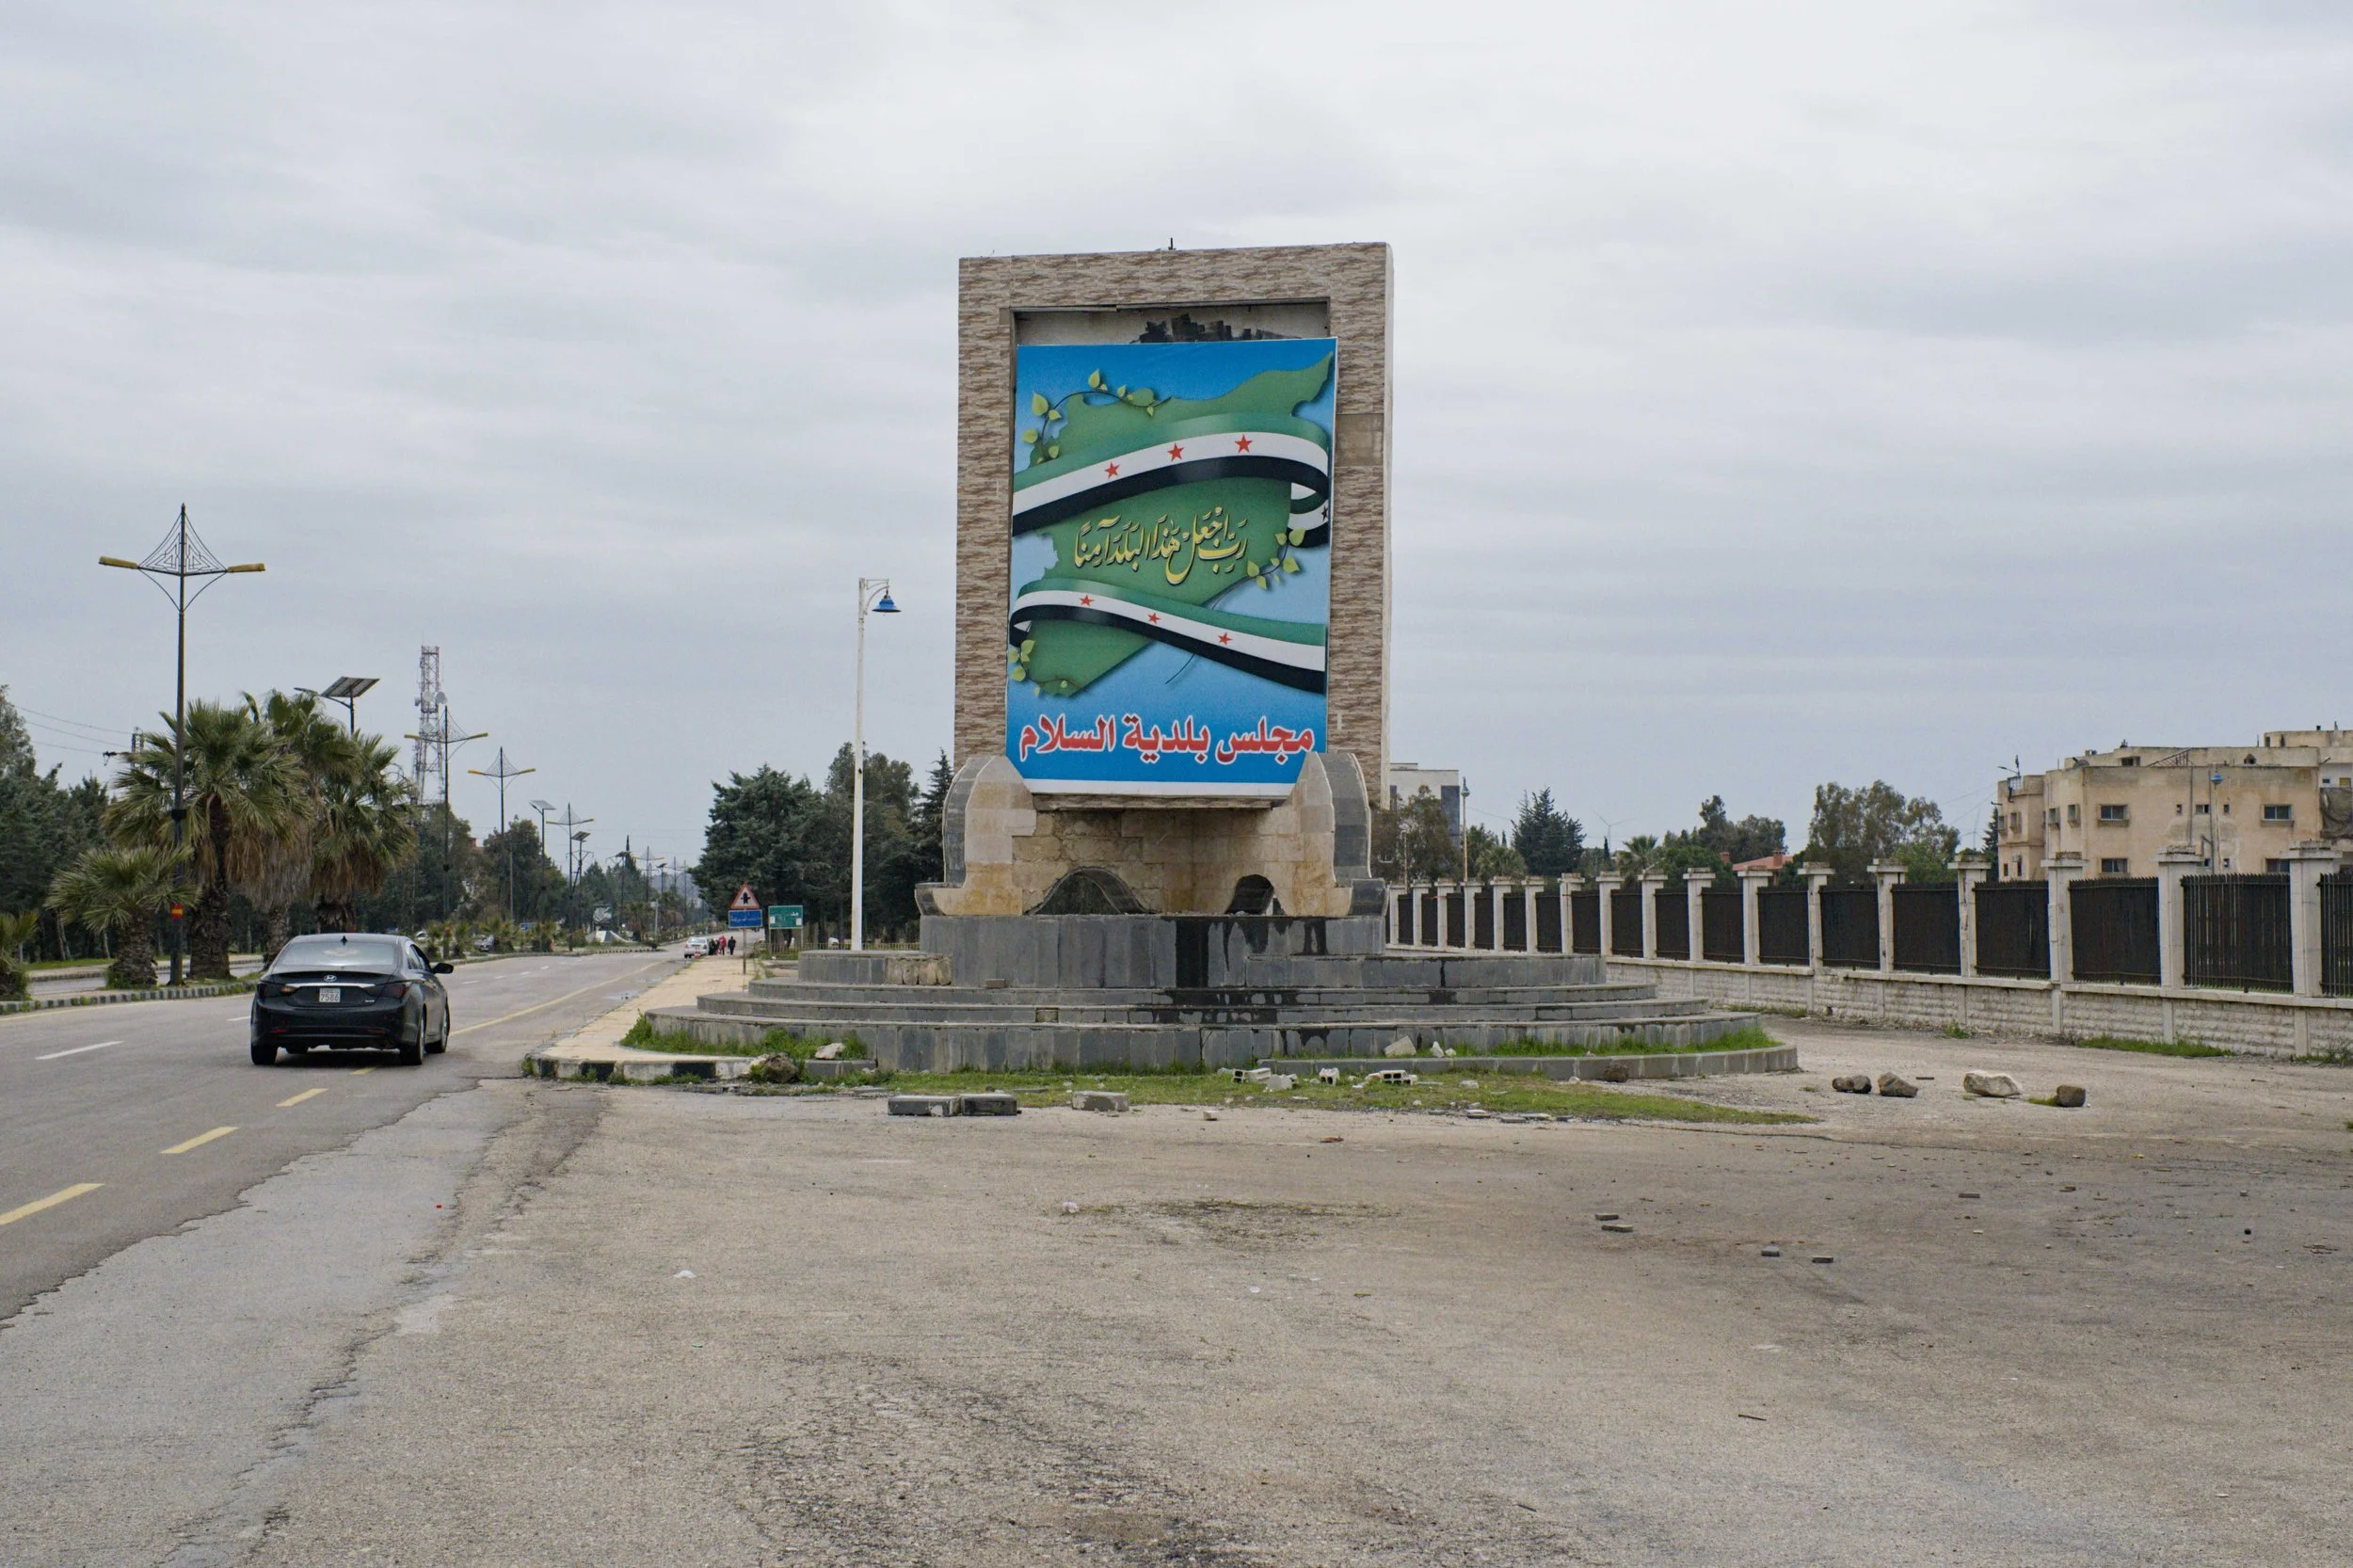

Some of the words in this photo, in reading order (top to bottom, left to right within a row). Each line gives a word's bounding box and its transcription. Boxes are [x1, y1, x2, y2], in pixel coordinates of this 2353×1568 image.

[1019, 713, 1115, 761] السلام
[1122, 714, 1210, 763] بلدية
[1216, 715, 1315, 764] مجلس
